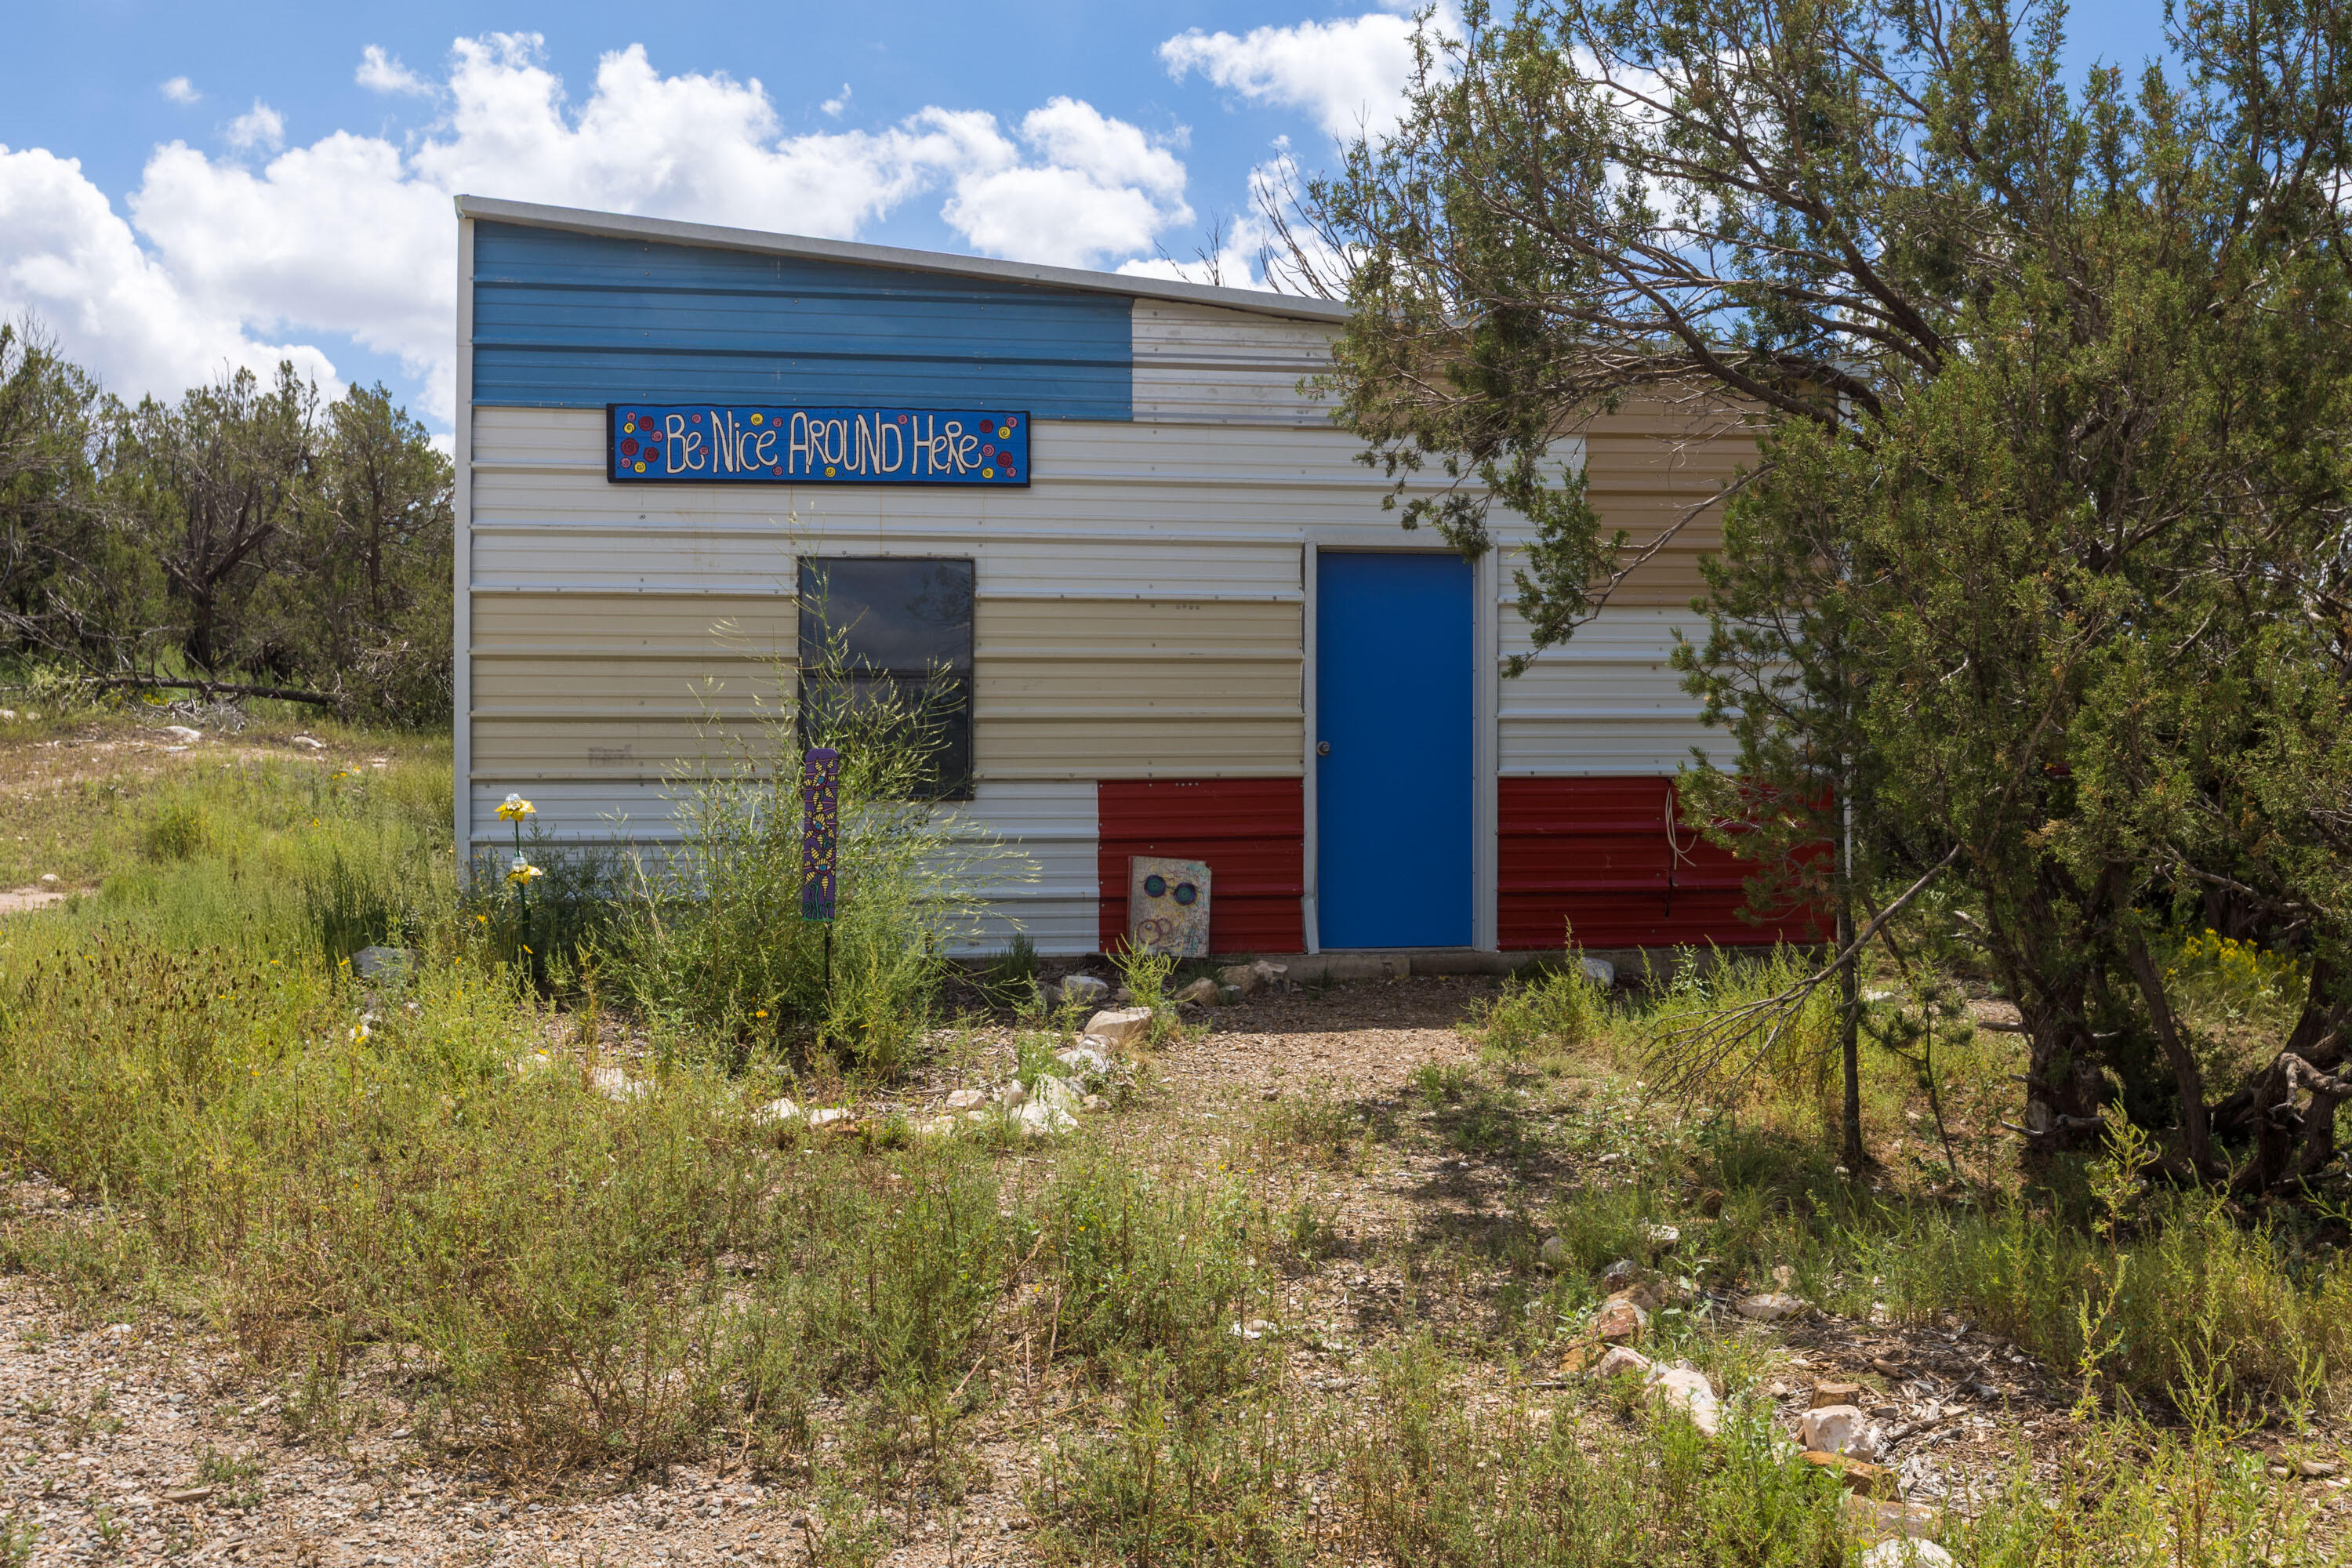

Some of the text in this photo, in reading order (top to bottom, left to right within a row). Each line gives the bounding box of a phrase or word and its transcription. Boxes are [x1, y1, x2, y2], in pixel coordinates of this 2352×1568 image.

[665, 414, 706, 474] Be
[710, 410, 779, 474] Nice
[788, 411, 903, 475] AROUND
